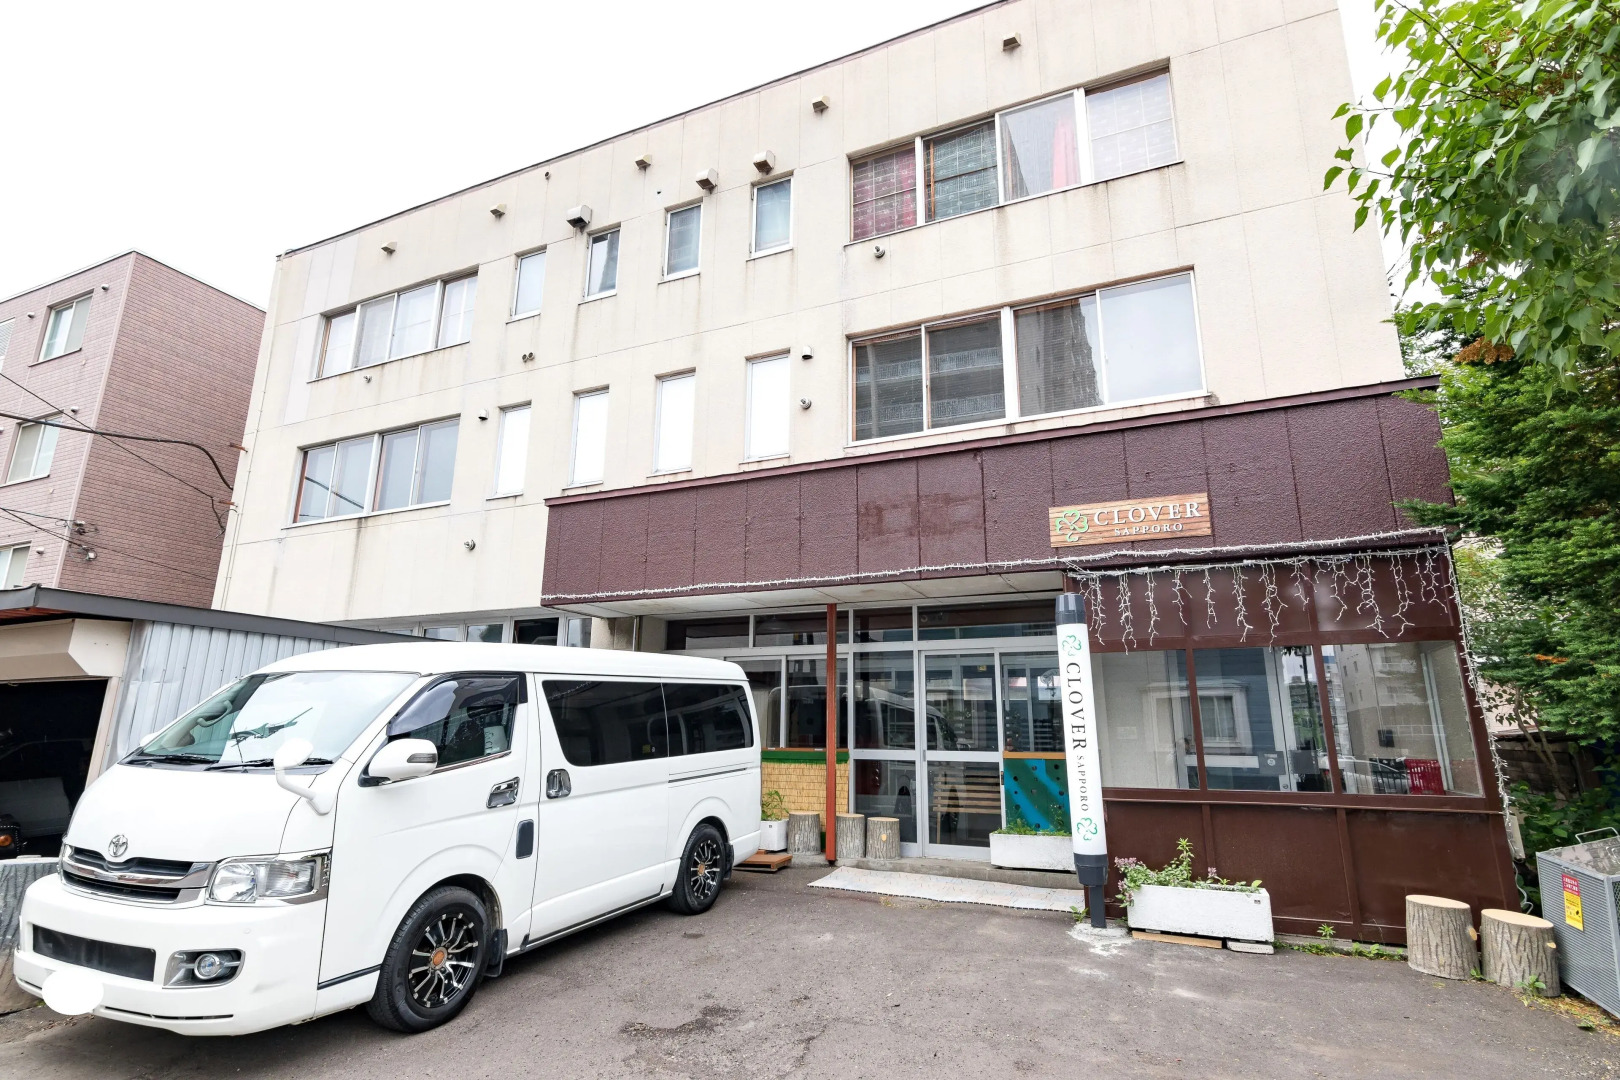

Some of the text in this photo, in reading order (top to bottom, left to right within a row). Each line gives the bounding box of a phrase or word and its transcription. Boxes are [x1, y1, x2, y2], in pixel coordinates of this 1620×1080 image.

[1093, 502, 1203, 526] CLOVER
[1114, 522, 1183, 537] SAPPORO
[1066, 662, 1089, 812] CLOVER SAPPORO
